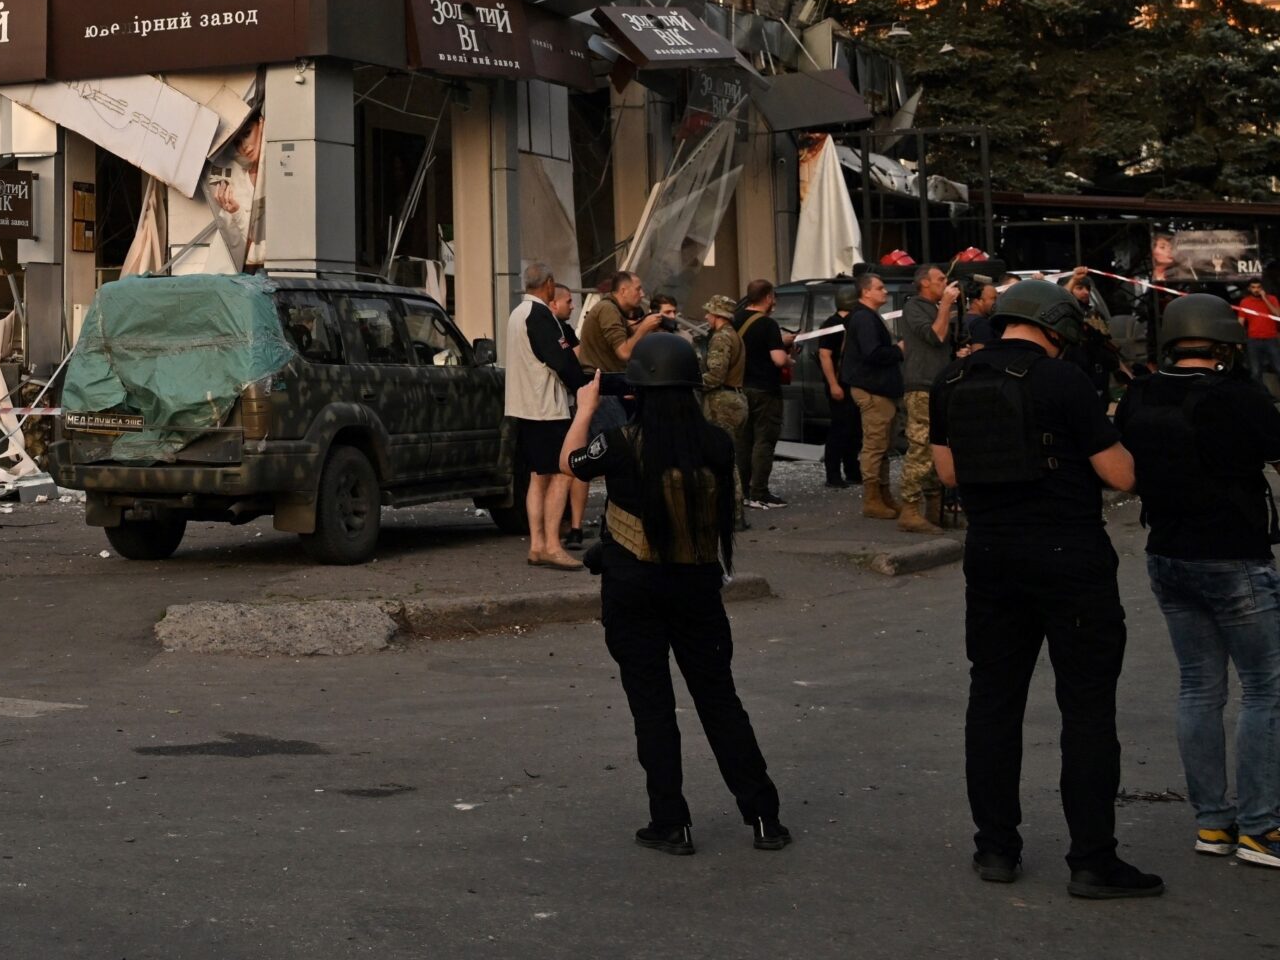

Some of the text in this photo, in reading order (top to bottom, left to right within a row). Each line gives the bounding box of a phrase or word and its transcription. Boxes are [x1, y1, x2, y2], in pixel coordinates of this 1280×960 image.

[199, 9, 258, 27] завод
[622, 10, 696, 32] ЗОЛТИЙ
[456, 23, 491, 53] ВІ
[652, 28, 694, 46] ВІК
[439, 52, 520, 70] ювеліний завод
[10, 219, 29, 227] завод
[67, 415, 86, 425] МЕД
